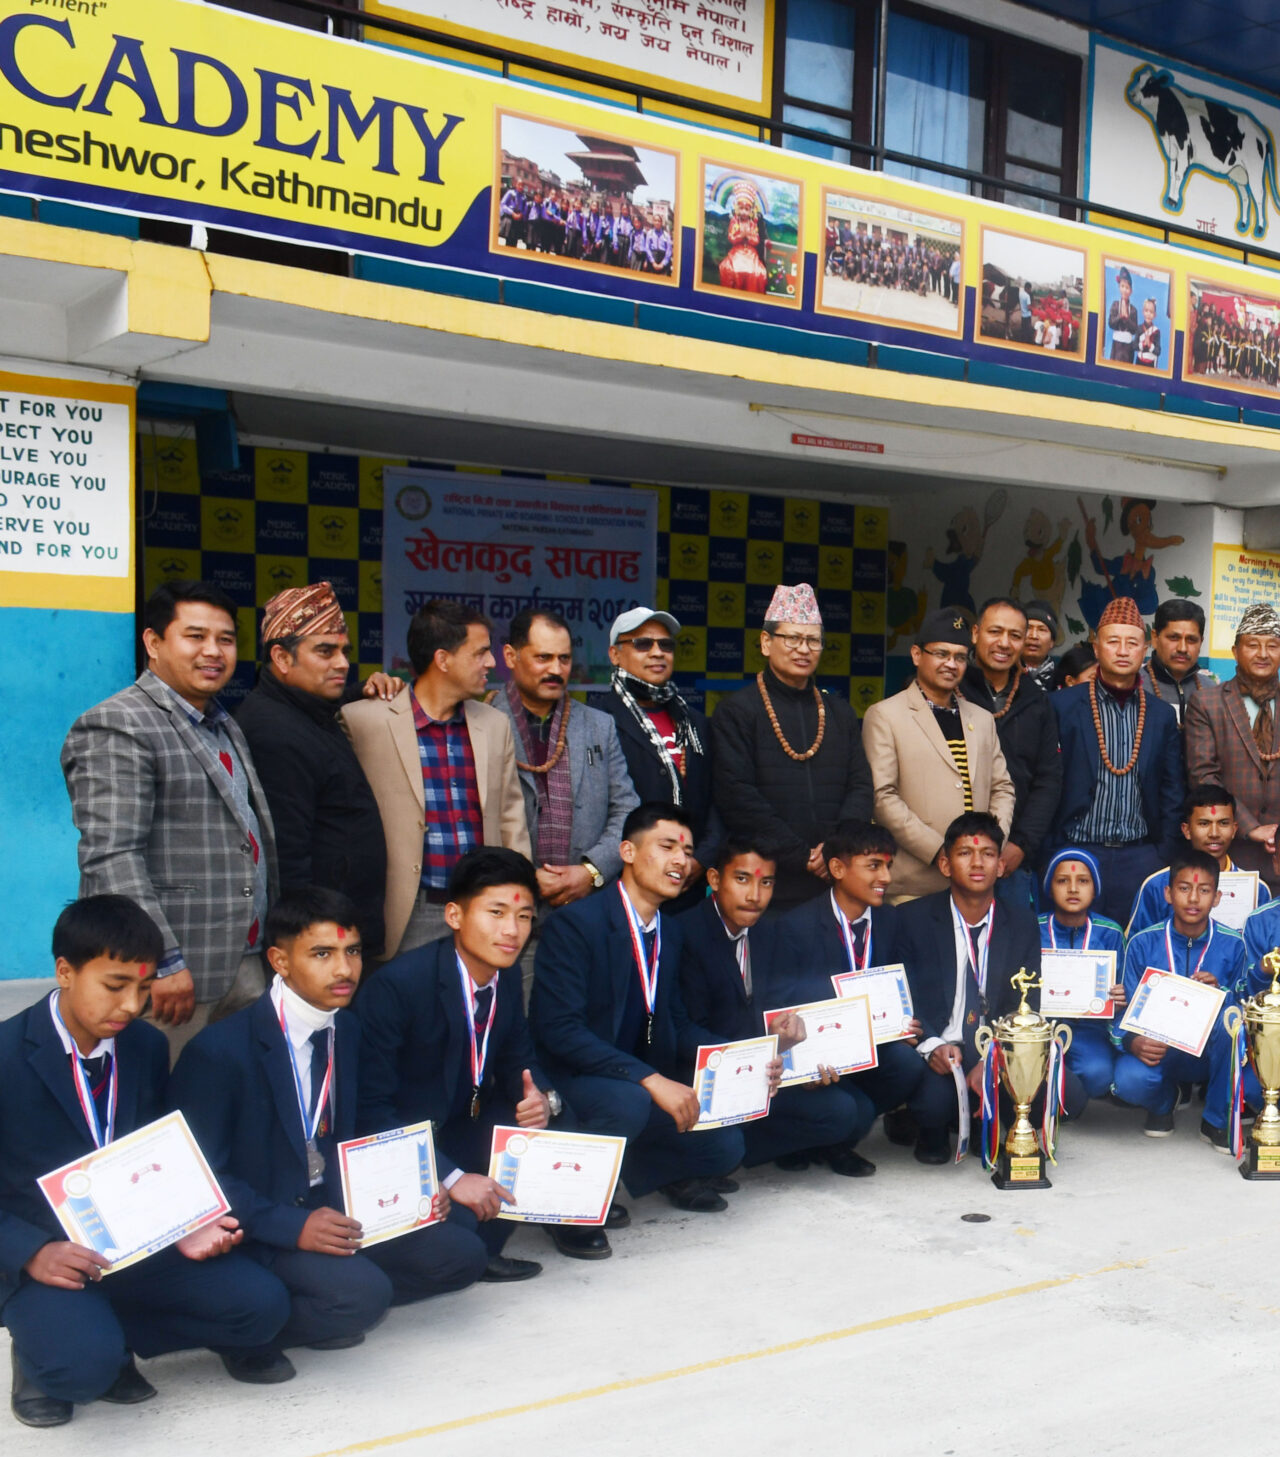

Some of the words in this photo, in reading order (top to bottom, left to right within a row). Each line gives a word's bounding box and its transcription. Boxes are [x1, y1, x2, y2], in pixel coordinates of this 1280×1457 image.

[600, 21, 629, 41] जय
[641, 32, 671, 53] जय
[0, 13, 465, 186] CADEMY
[0, 121, 205, 191] neshwor,
[220, 156, 443, 232] Kathmandu
[20, 400, 56, 418] FOR
[66, 404, 103, 422] YOU
[51, 427, 93, 445] YOU
[50, 450, 87, 467] YOU
[71, 475, 106, 492] YOU
[22, 494, 61, 511] YOU
[53, 520, 90, 537] YOU
[36, 542, 71, 558] FOR
[82, 545, 119, 560] YOU
[404, 527, 535, 583] खेलकुद
[545, 545, 642, 583] सप्ताह
[1239, 554, 1267, 568] Morning
